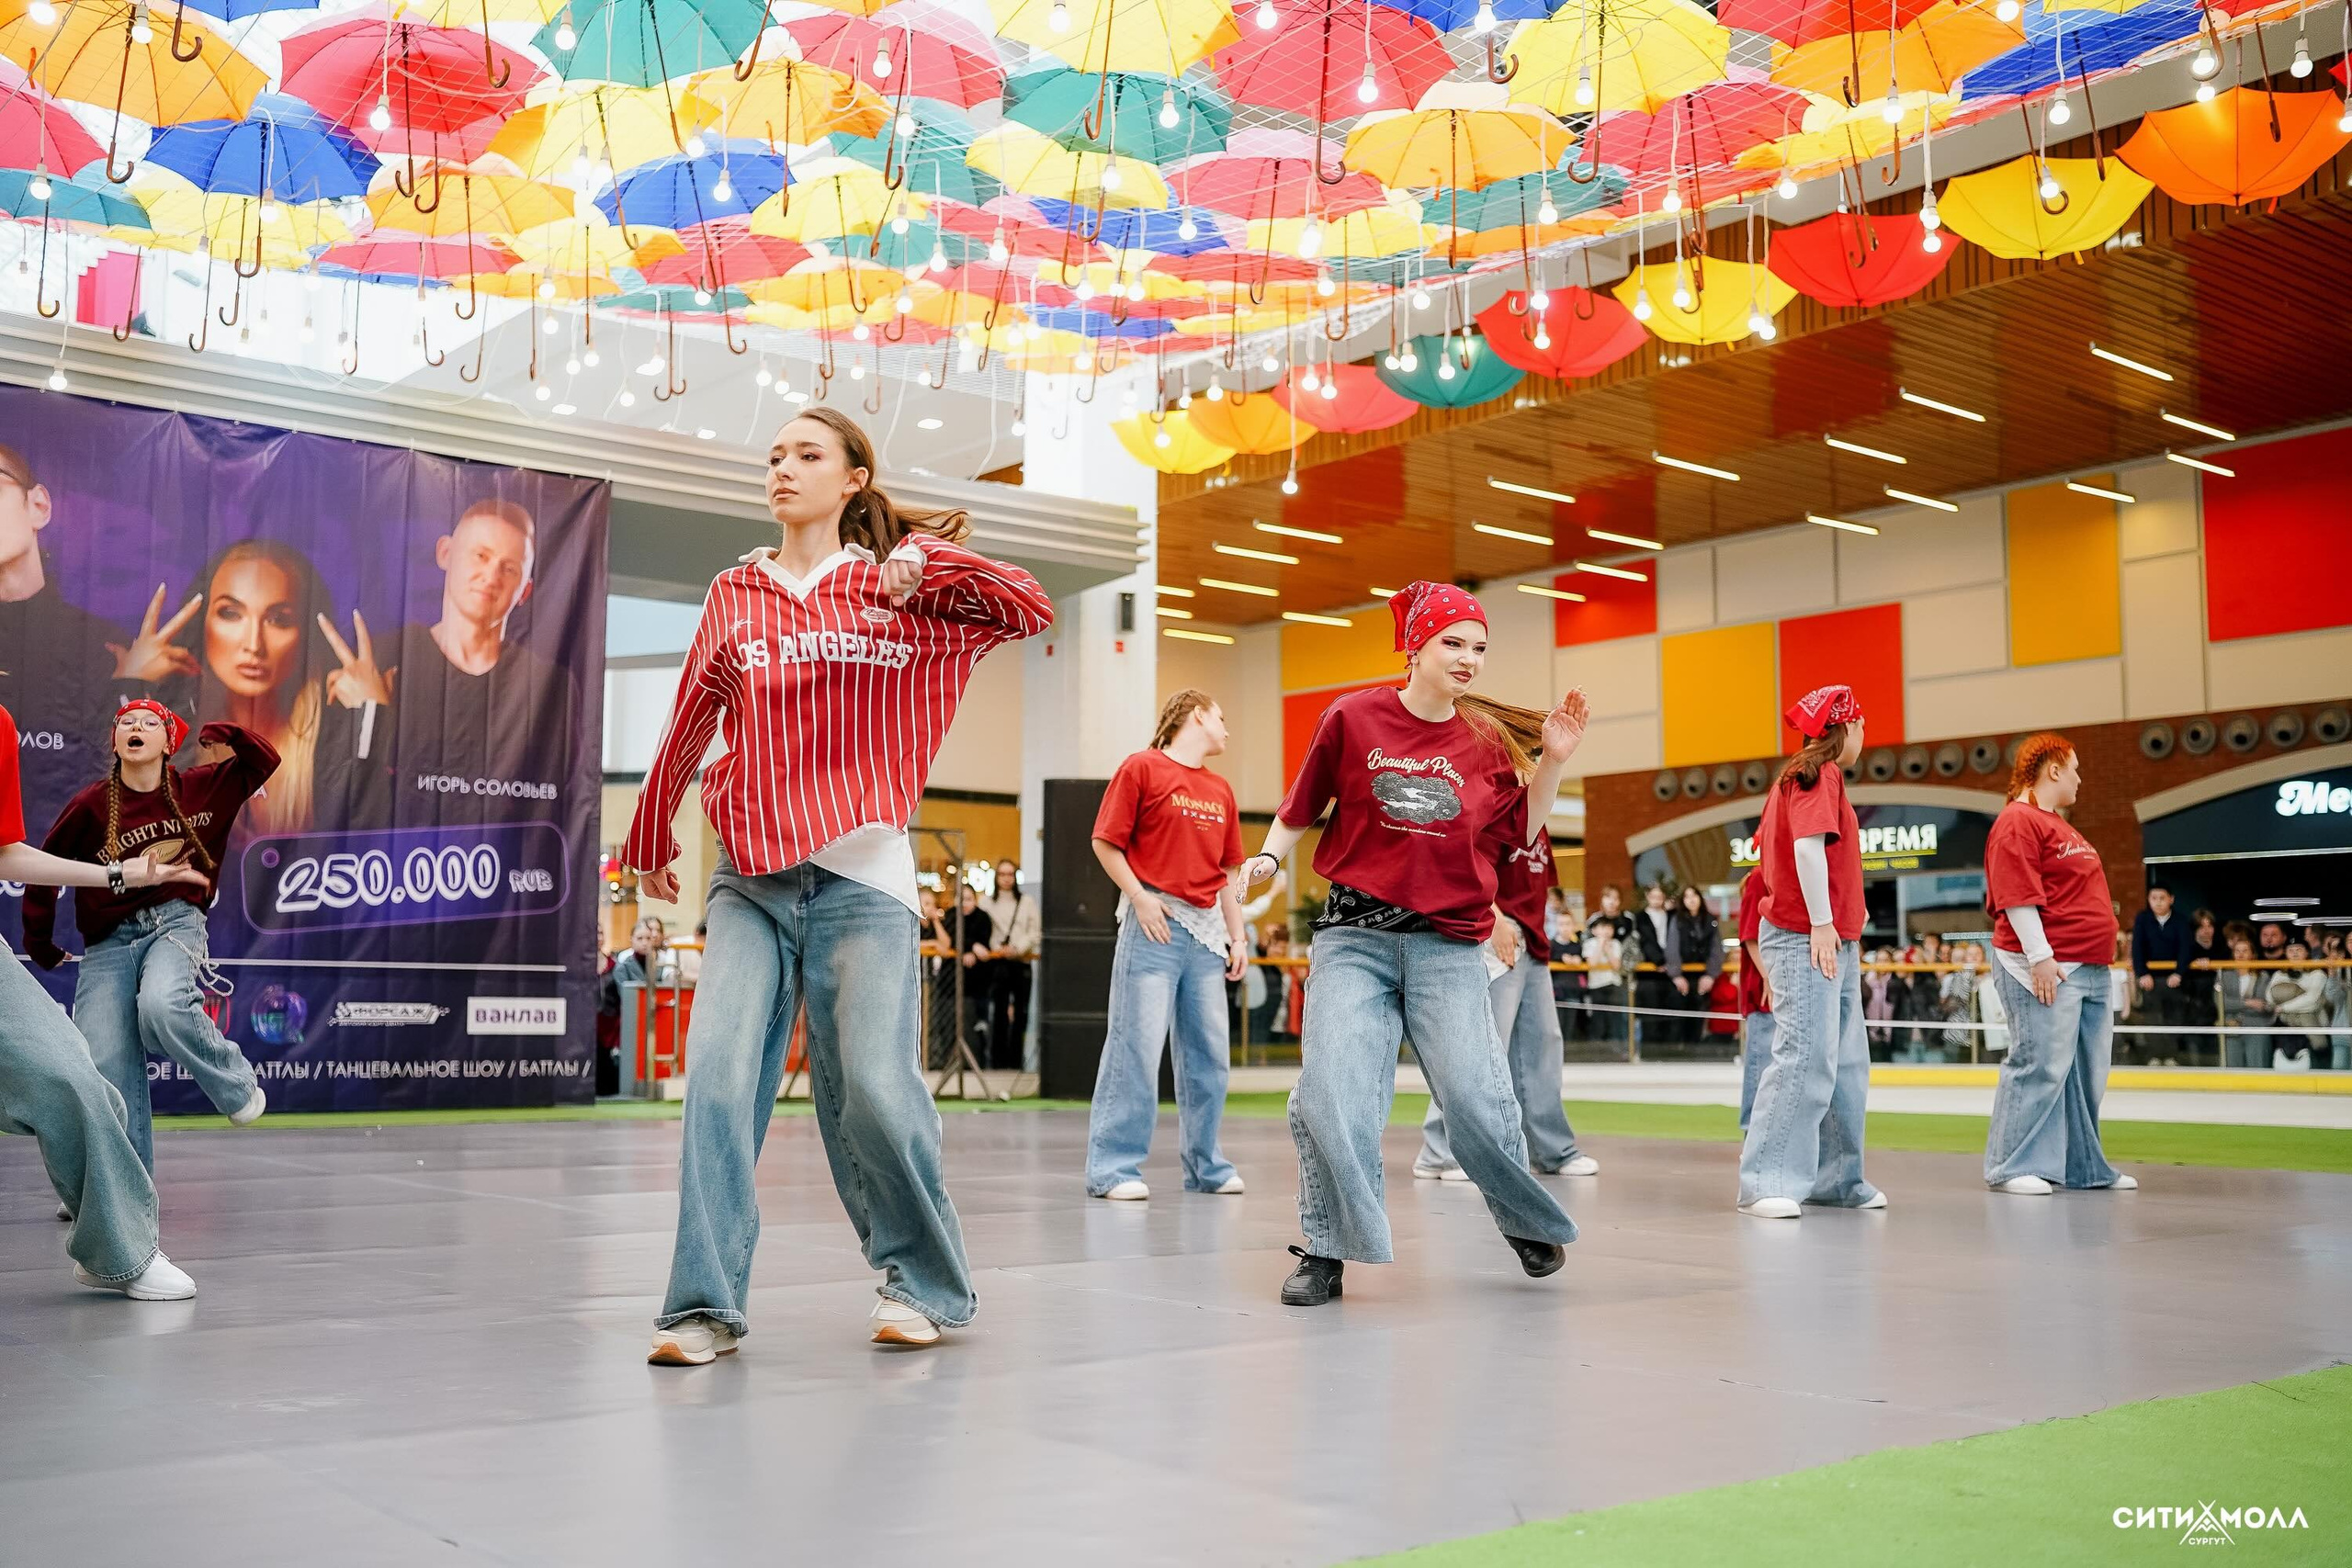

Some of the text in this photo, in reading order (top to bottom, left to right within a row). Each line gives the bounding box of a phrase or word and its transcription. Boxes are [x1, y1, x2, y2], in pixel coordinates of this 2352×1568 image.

[732, 630, 913, 672] OS ANGELES
[1367, 747, 1465, 787] Beautiful Places
[417, 774, 559, 800] ИГОРЬ СОЛОВЬЕВ
[1170, 793, 1226, 817] MONACO
[275, 843, 554, 913] 250.000 RUB
[254, 1060, 310, 1079] АТТЛЫ
[326, 1059, 459, 1080] ТАНЦЕВАЛЬНОЕ
[463, 1059, 505, 1078] ШОУ
[519, 1059, 580, 1078] БАТТЛЫ
